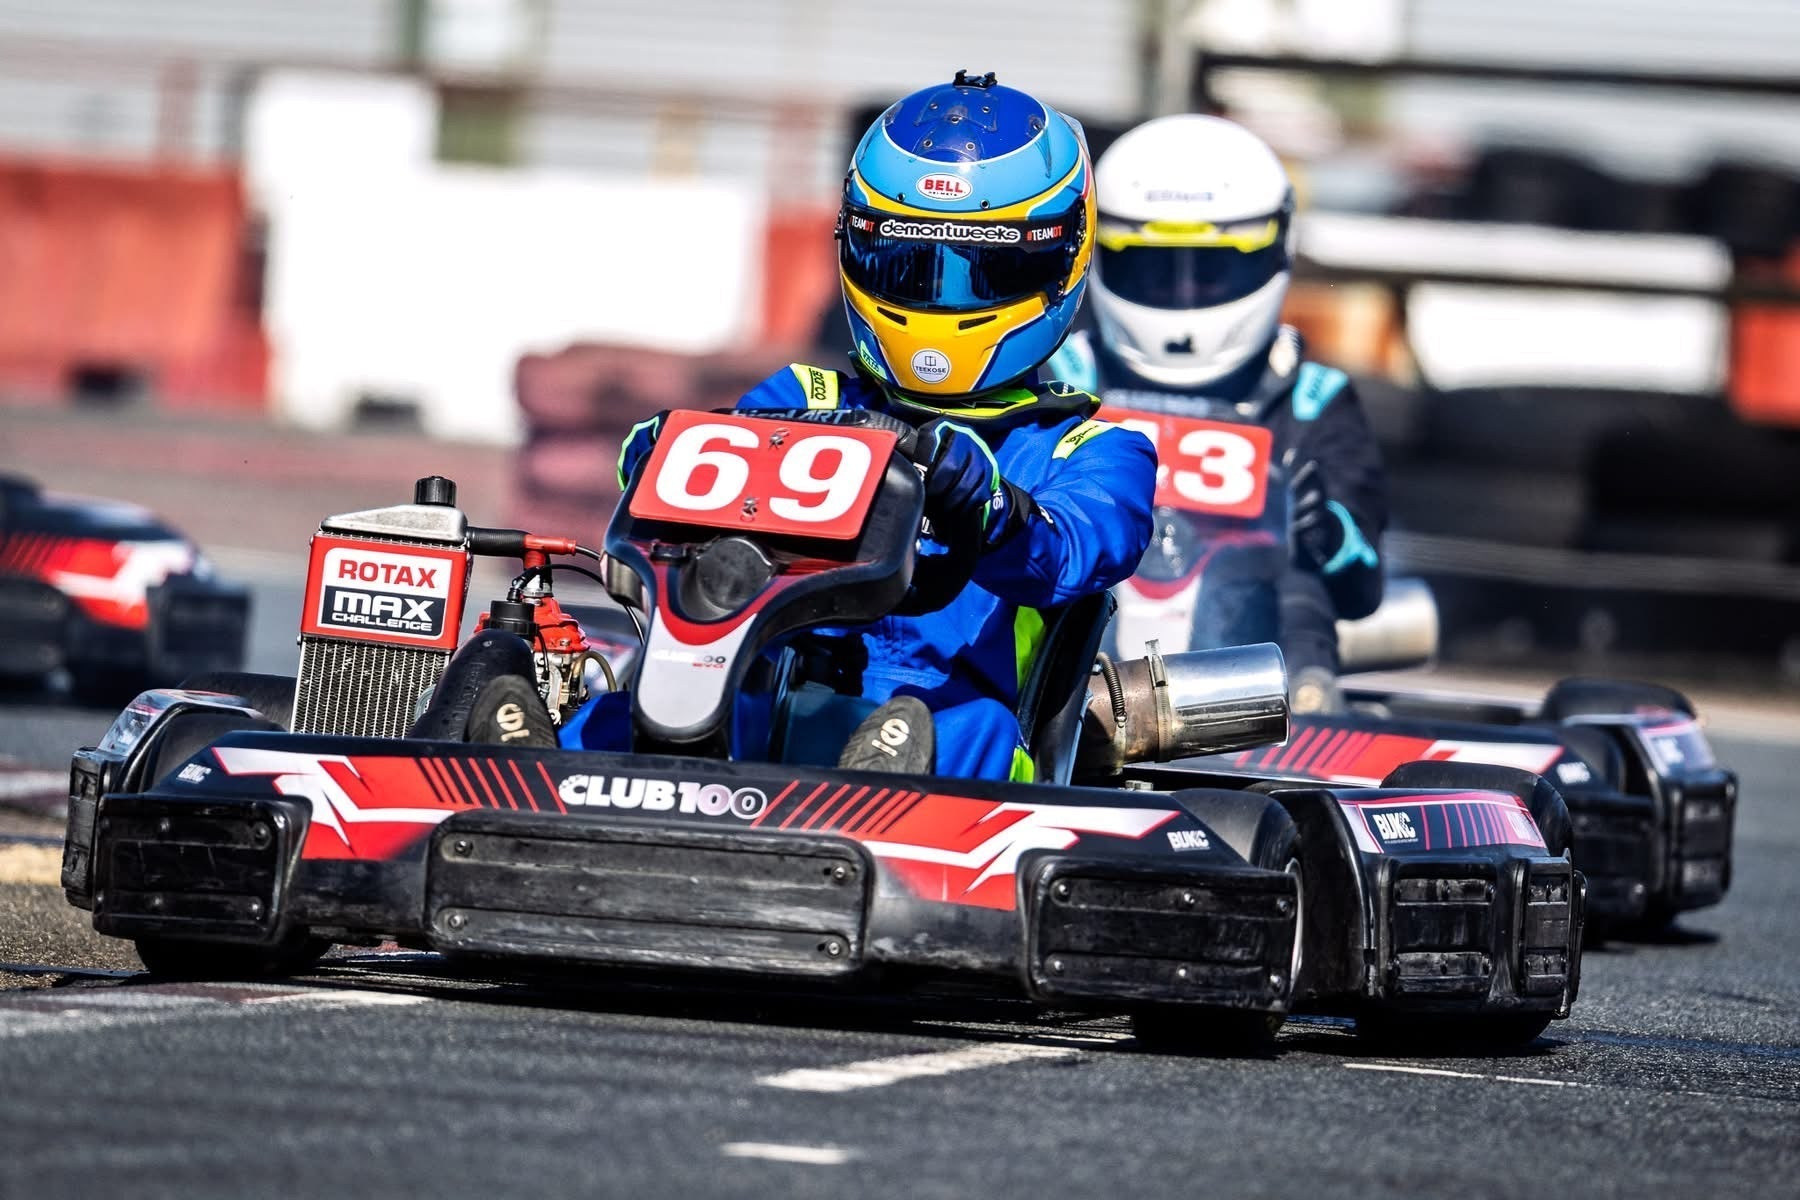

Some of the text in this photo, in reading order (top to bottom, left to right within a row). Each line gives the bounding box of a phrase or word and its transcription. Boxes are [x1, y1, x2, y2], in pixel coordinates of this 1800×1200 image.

[924, 179, 963, 193] BELL
[880, 219, 1020, 243] demontweeks
[915, 365, 946, 374] TEEKOSE
[656, 424, 872, 522] 69
[1121, 417, 1256, 505] 3
[338, 559, 437, 589] ROTAX
[333, 590, 434, 622] MAX
[331, 612, 433, 632] CHALLENGE
[558, 774, 768, 820] CLUB100
[1167, 829, 1209, 849] BUKC
